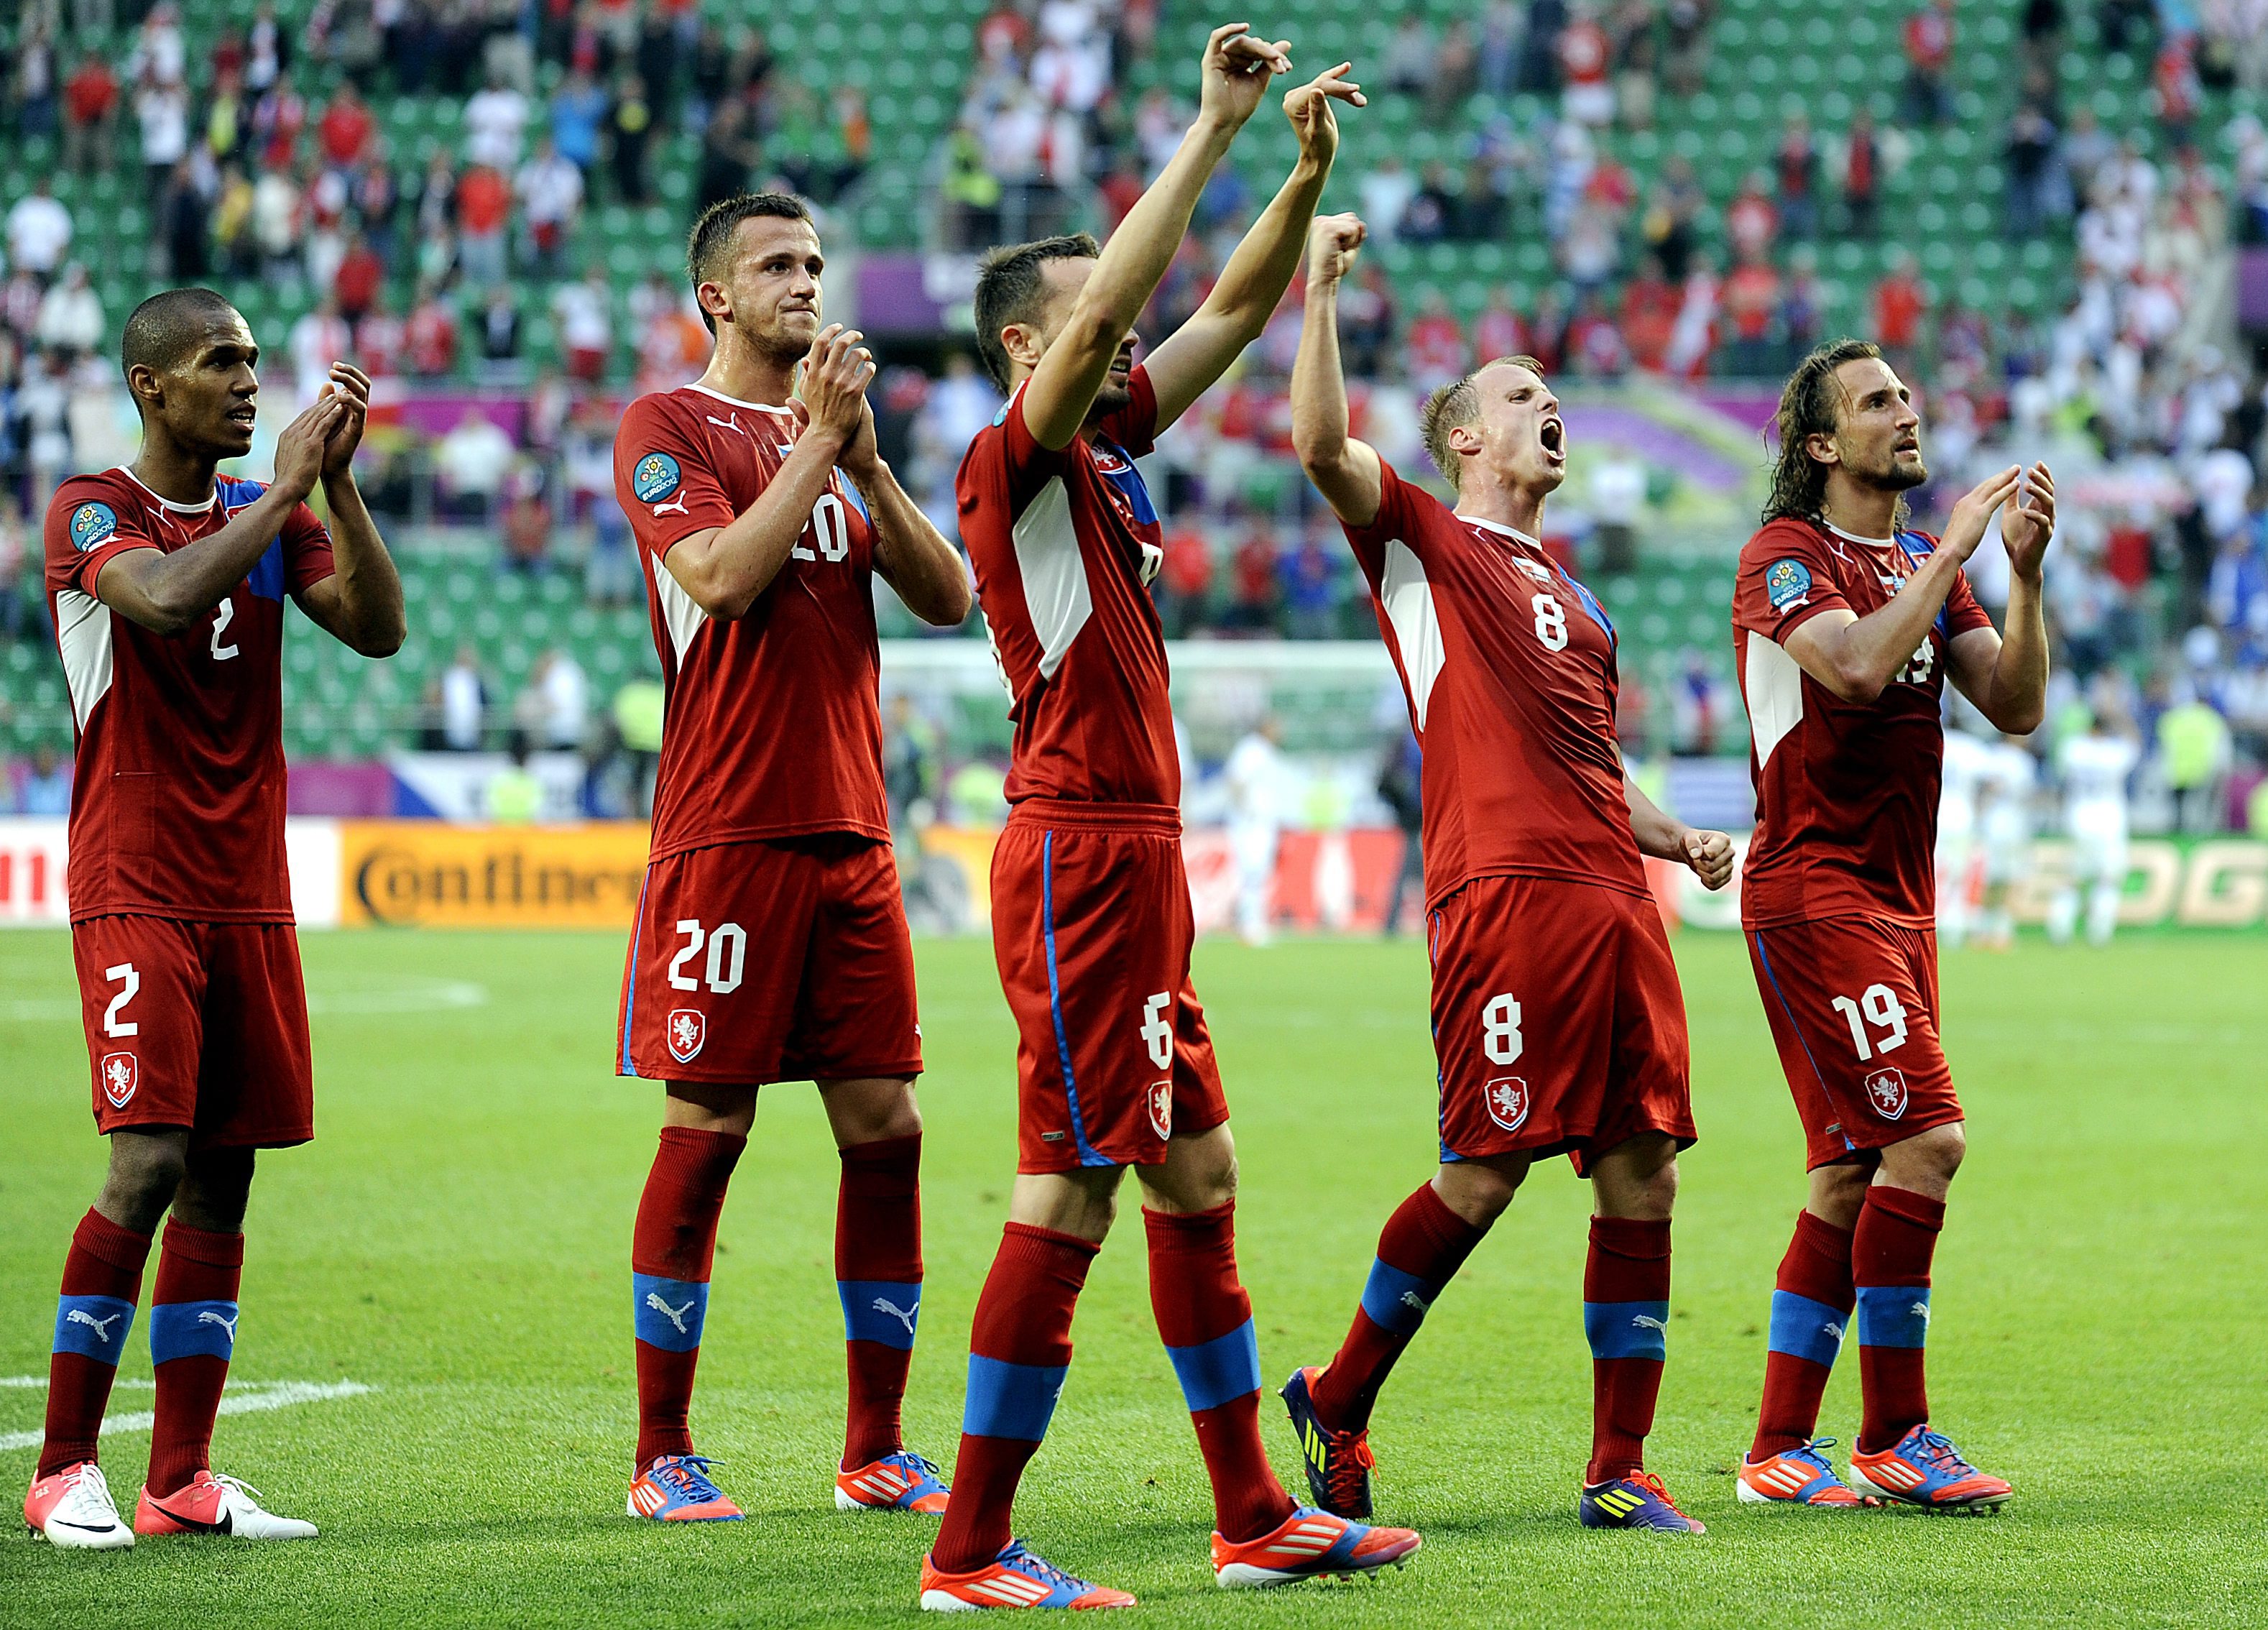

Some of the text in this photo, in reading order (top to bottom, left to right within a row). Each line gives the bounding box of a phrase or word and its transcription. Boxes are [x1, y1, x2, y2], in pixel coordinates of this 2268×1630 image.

[211, 597, 239, 660] 2
[1531, 593, 1569, 653] 8
[1896, 635, 1935, 683] 9
[668, 919, 747, 994] 20
[103, 962, 139, 1039] 2
[1140, 990, 1174, 1070] 6
[1483, 993, 1523, 1065] 8
[1831, 983, 1909, 1061] 19
